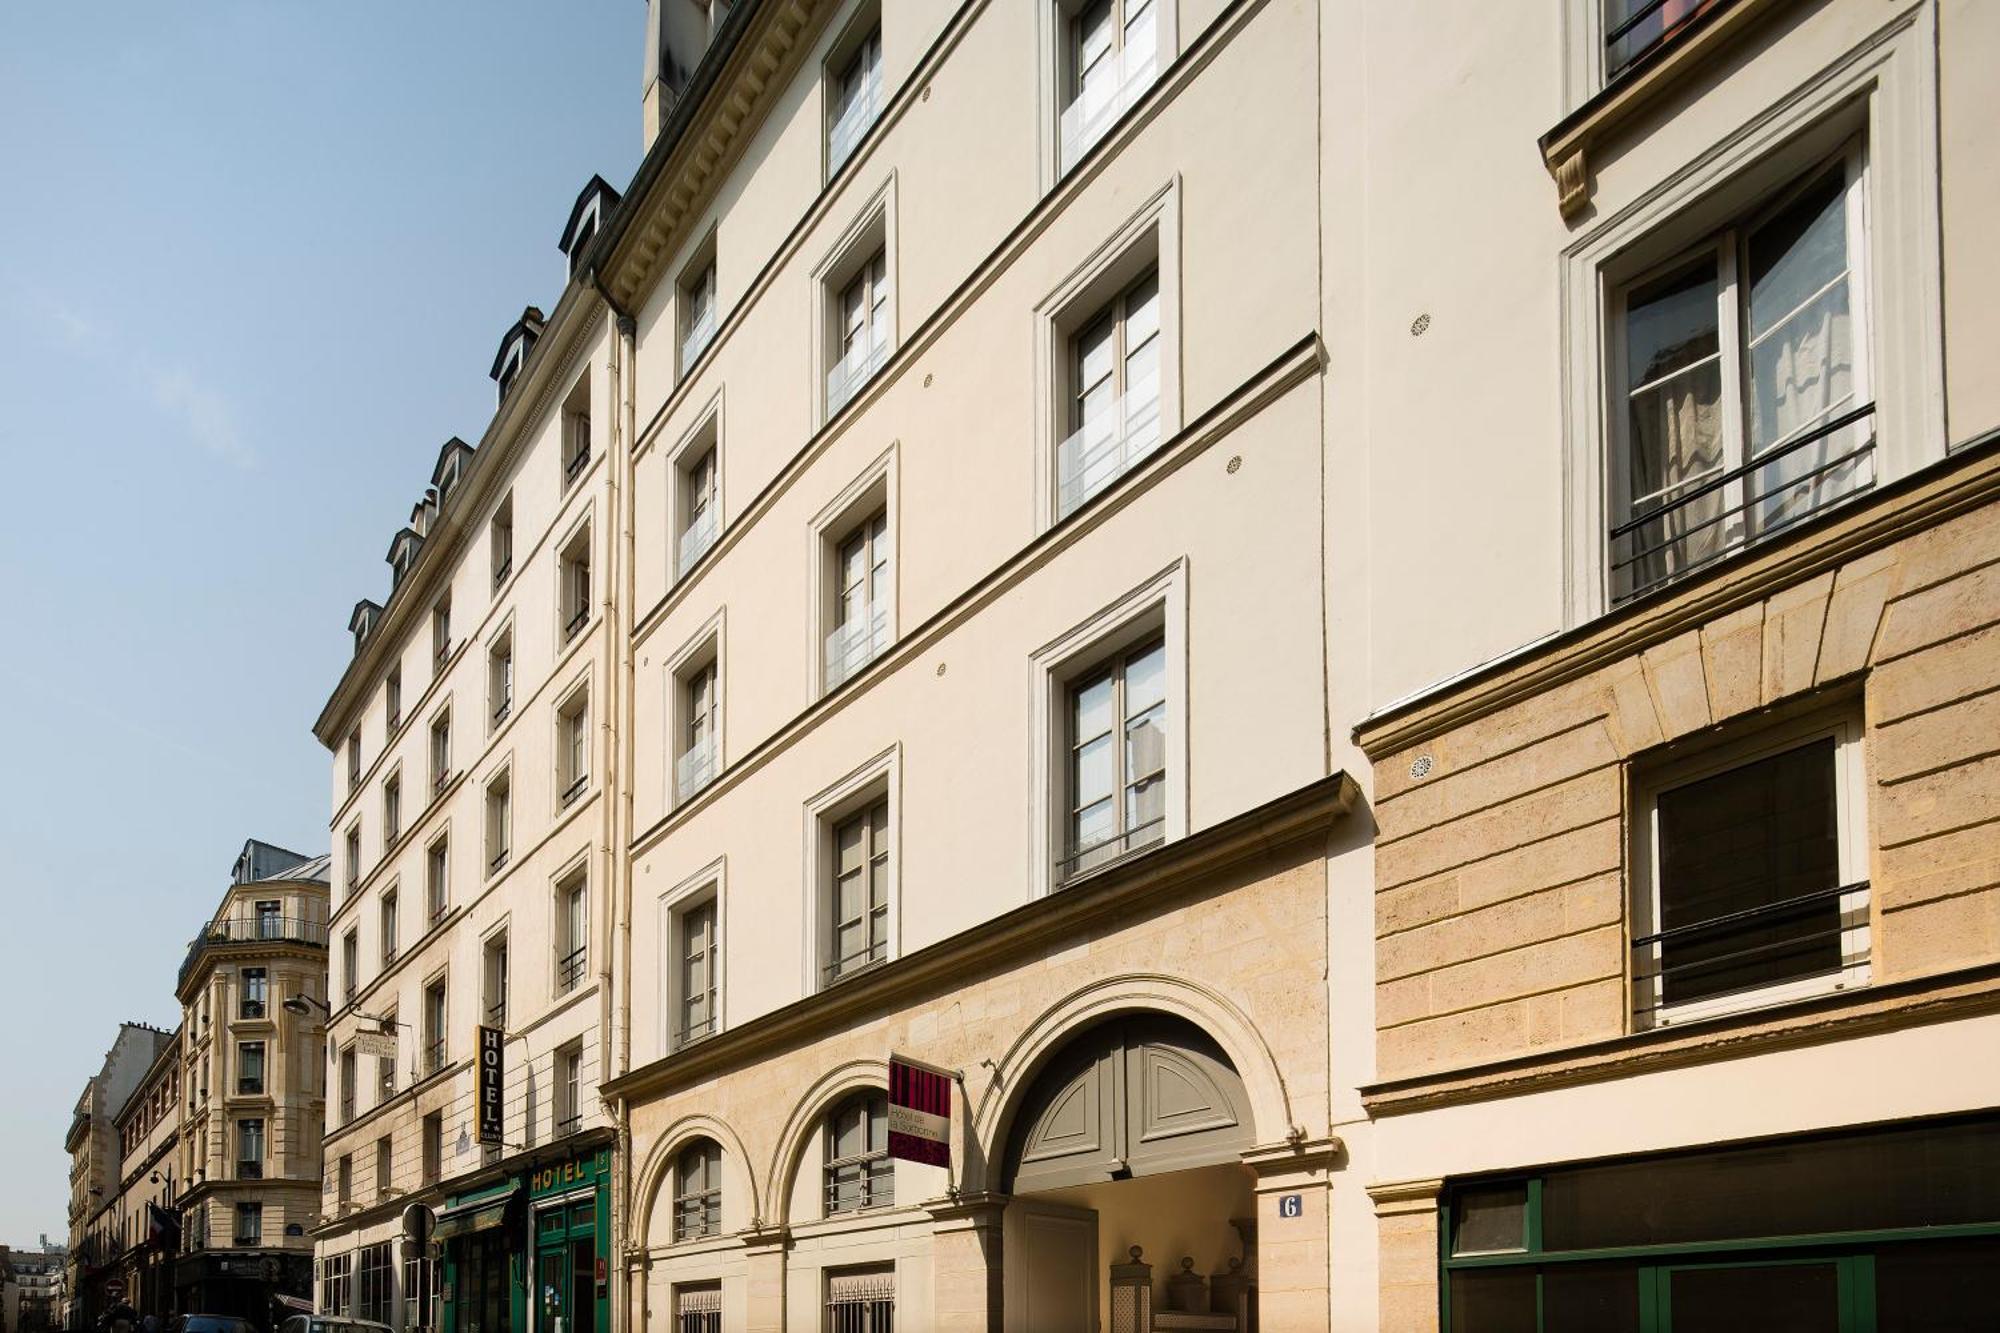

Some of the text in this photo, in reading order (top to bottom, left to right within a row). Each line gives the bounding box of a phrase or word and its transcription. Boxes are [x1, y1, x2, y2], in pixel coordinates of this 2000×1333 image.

[484, 1031, 498, 1122] HOTEL
[532, 1159, 585, 1191] HOTEL
[1285, 1196, 1297, 1216] 6
